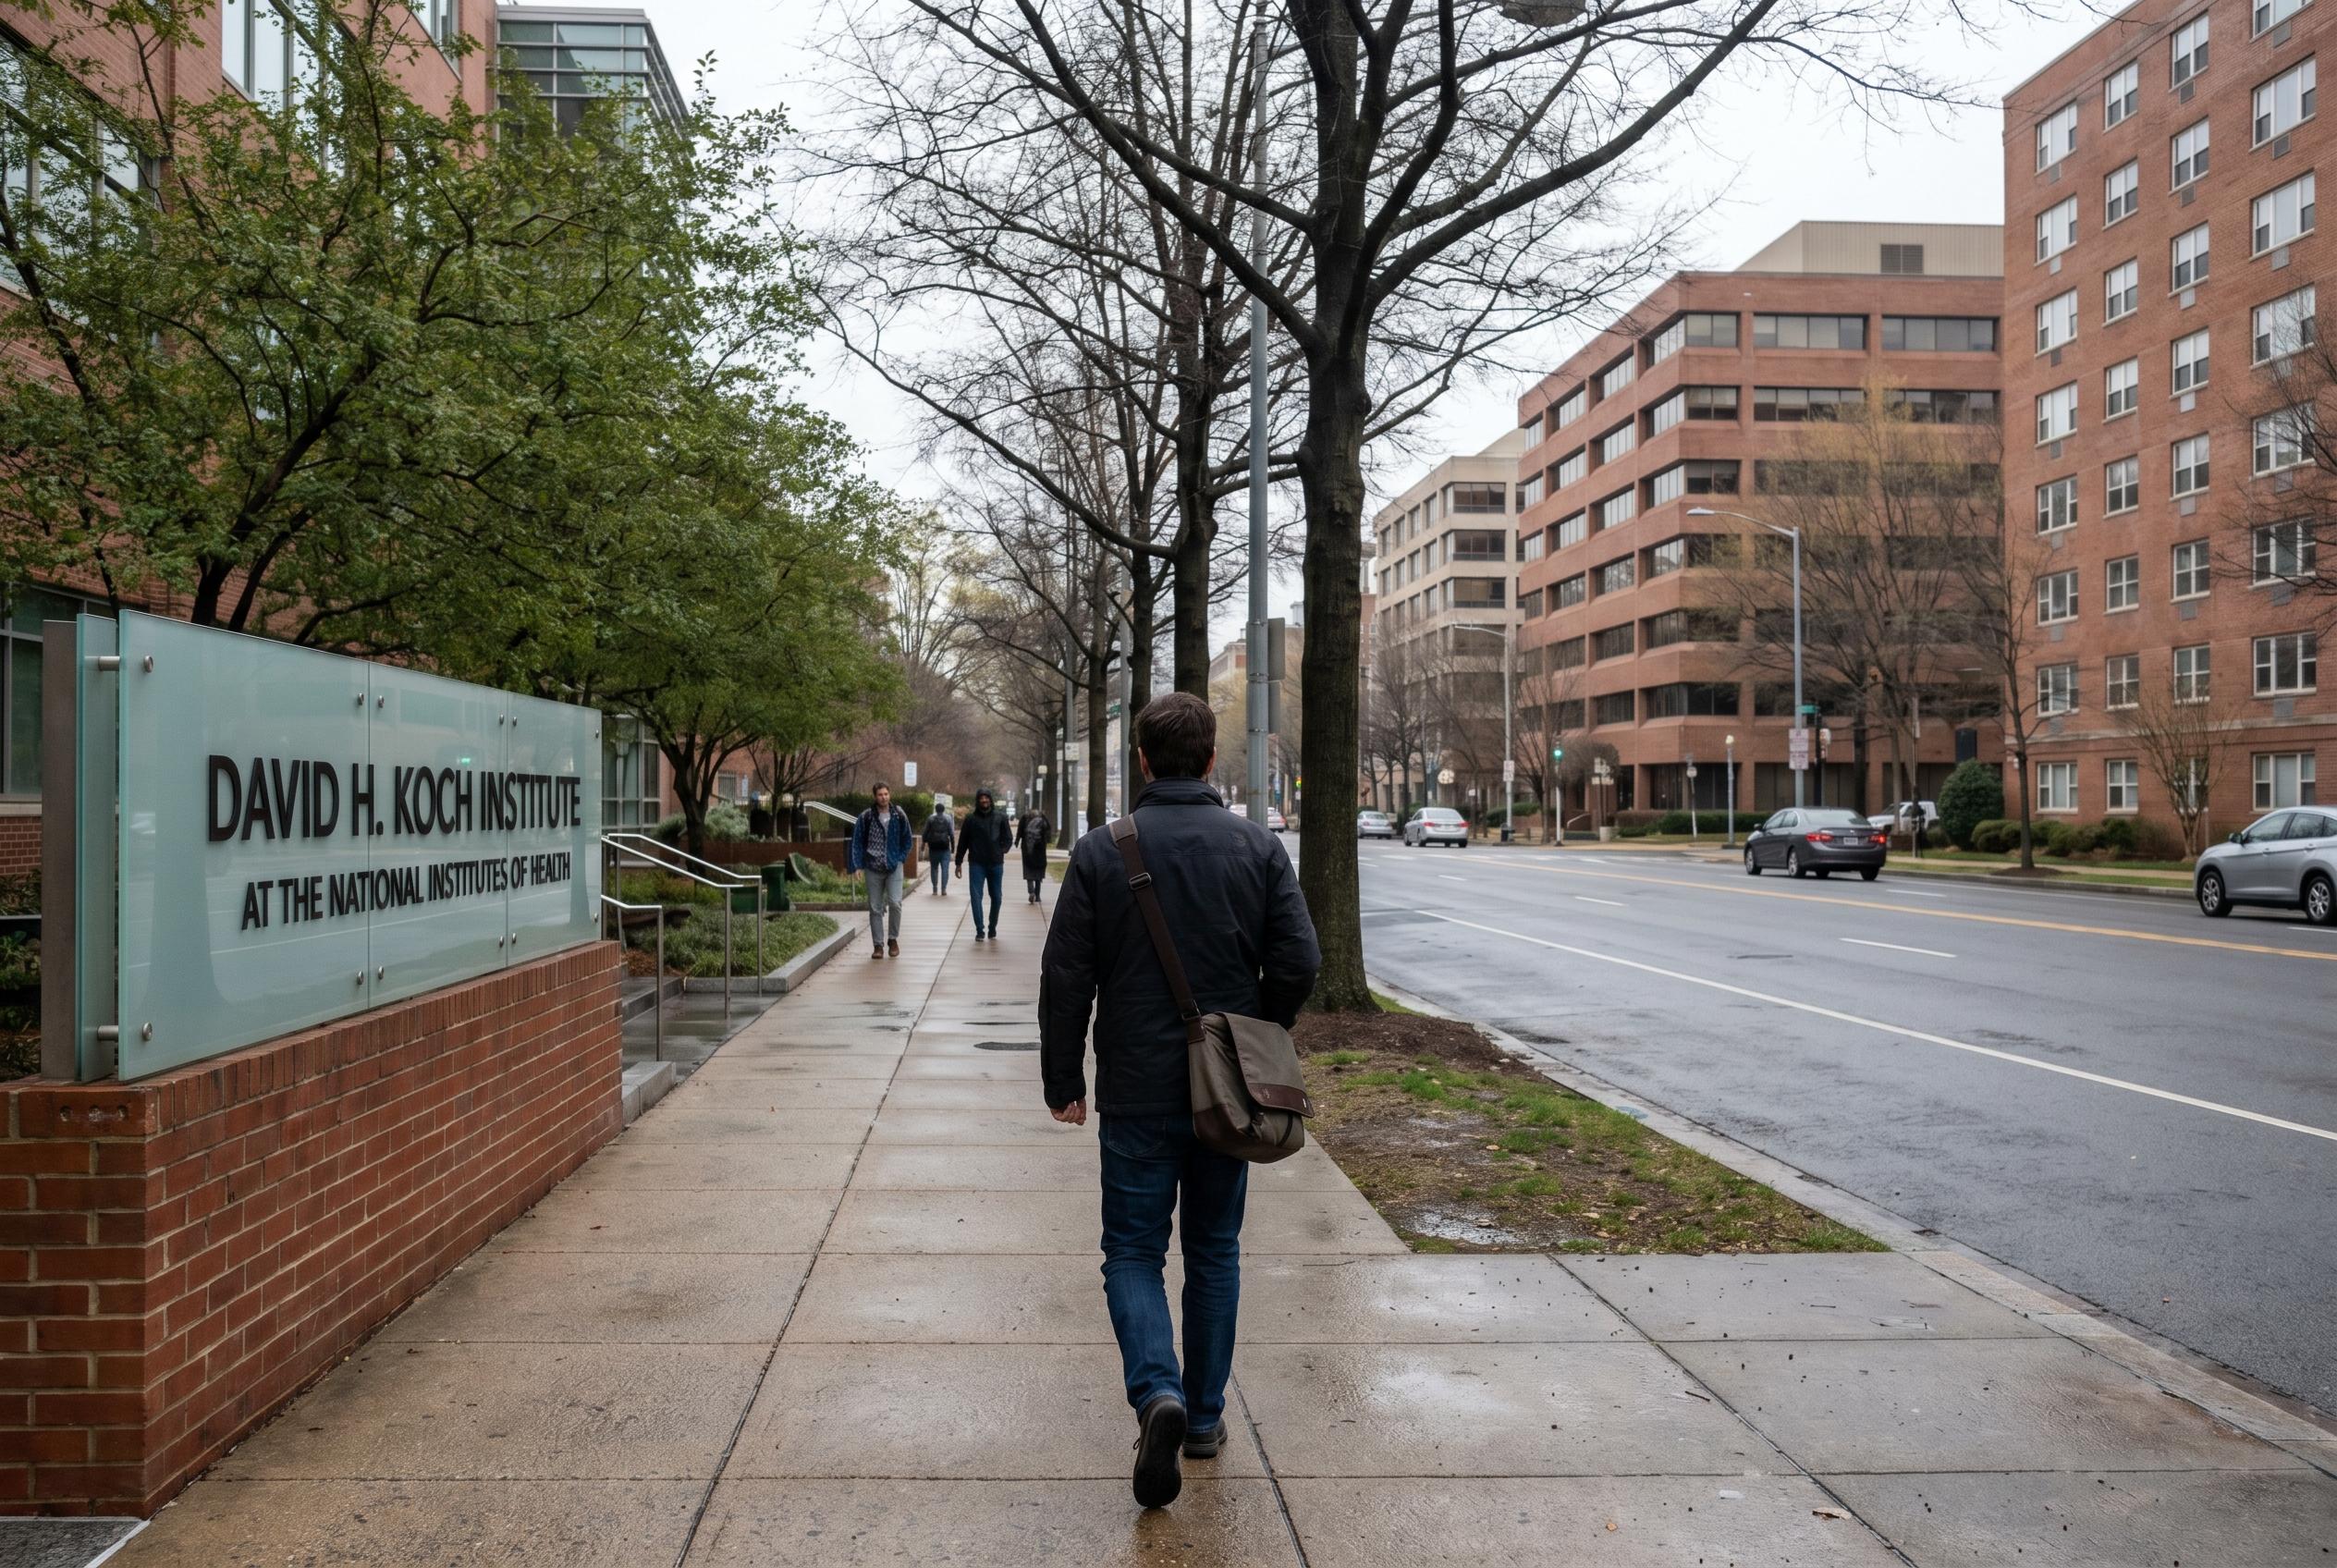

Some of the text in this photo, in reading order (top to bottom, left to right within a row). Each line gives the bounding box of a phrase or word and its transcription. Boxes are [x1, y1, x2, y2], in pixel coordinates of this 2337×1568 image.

[209, 754, 581, 842] DAVID H. KOCH INSTITUTE
[240, 851, 570, 930] AT THE NATIONAL INSTITUTES OF HEALTH
